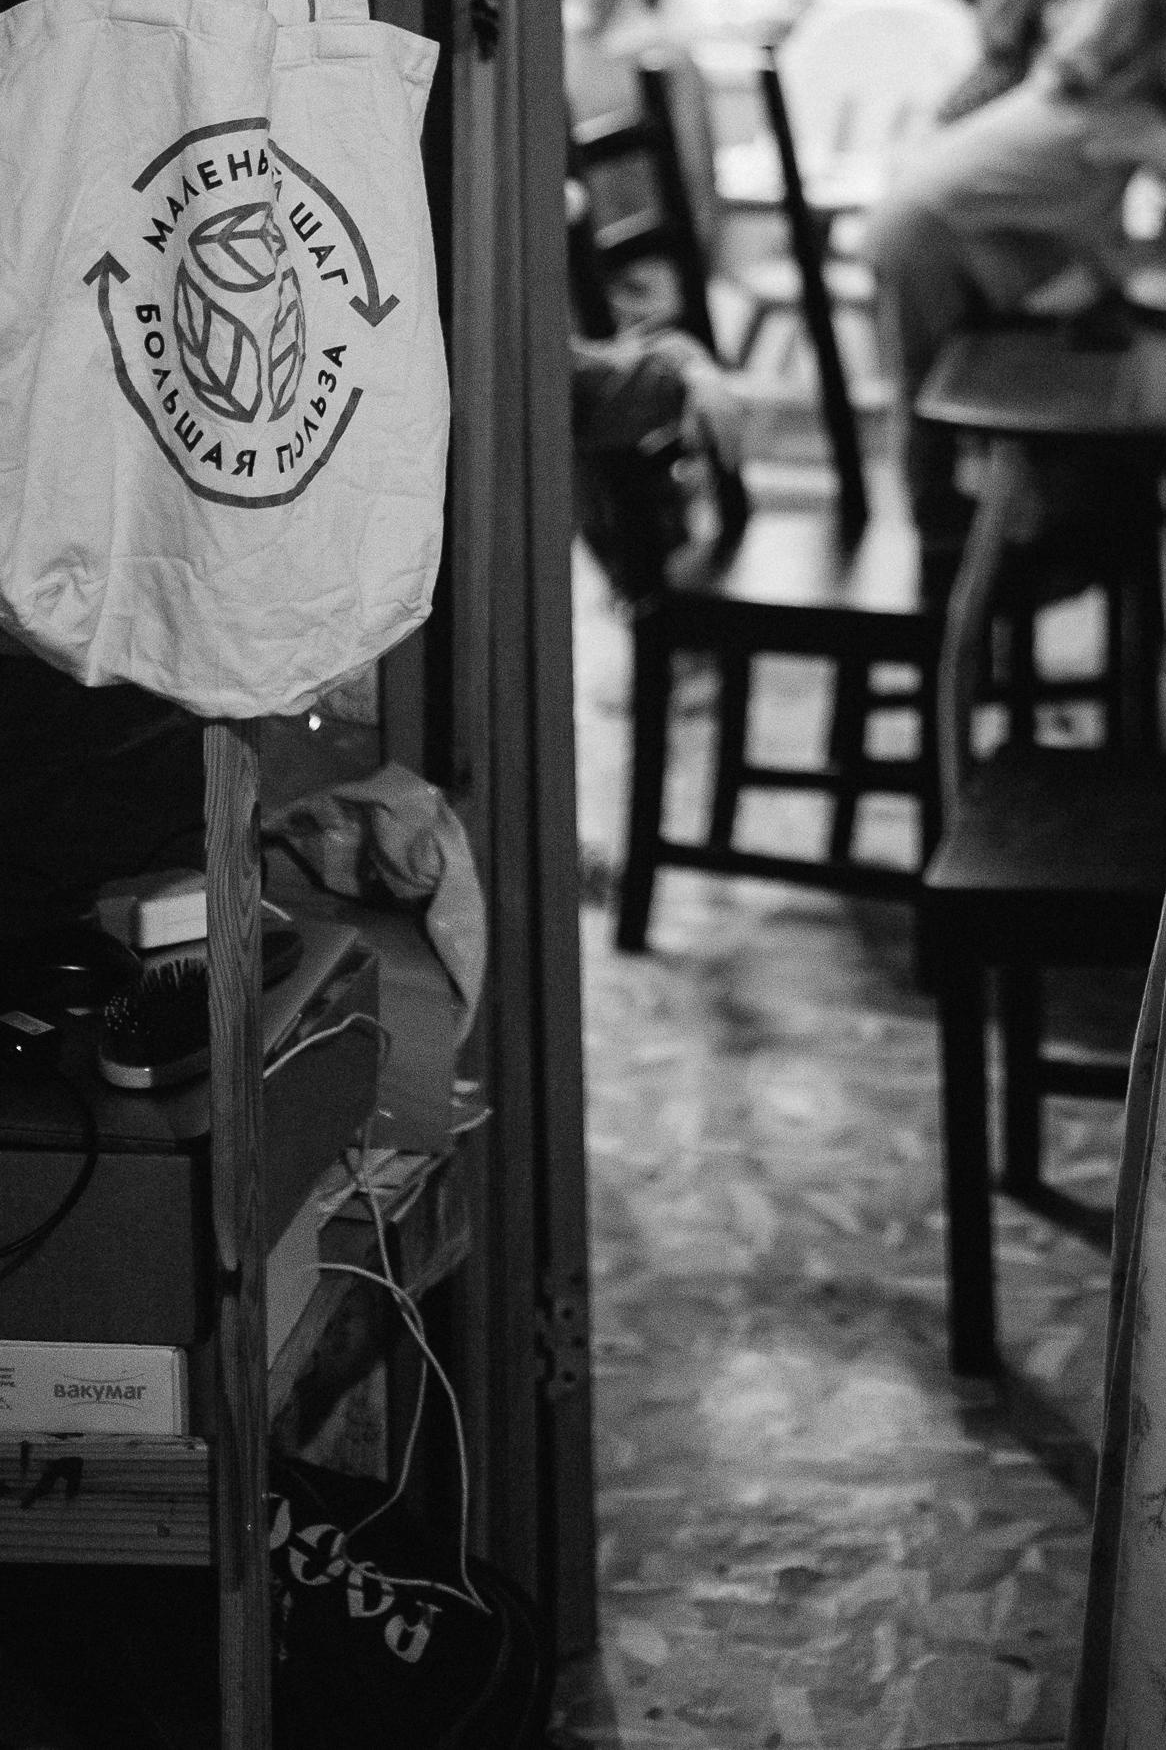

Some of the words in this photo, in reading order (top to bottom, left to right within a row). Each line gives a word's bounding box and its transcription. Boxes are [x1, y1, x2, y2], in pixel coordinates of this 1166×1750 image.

[288, 201, 349, 286] ШАГ
[135, 303, 257, 478] БОЛЬШАЯ
[53, 1383, 147, 1401] вакумаг
